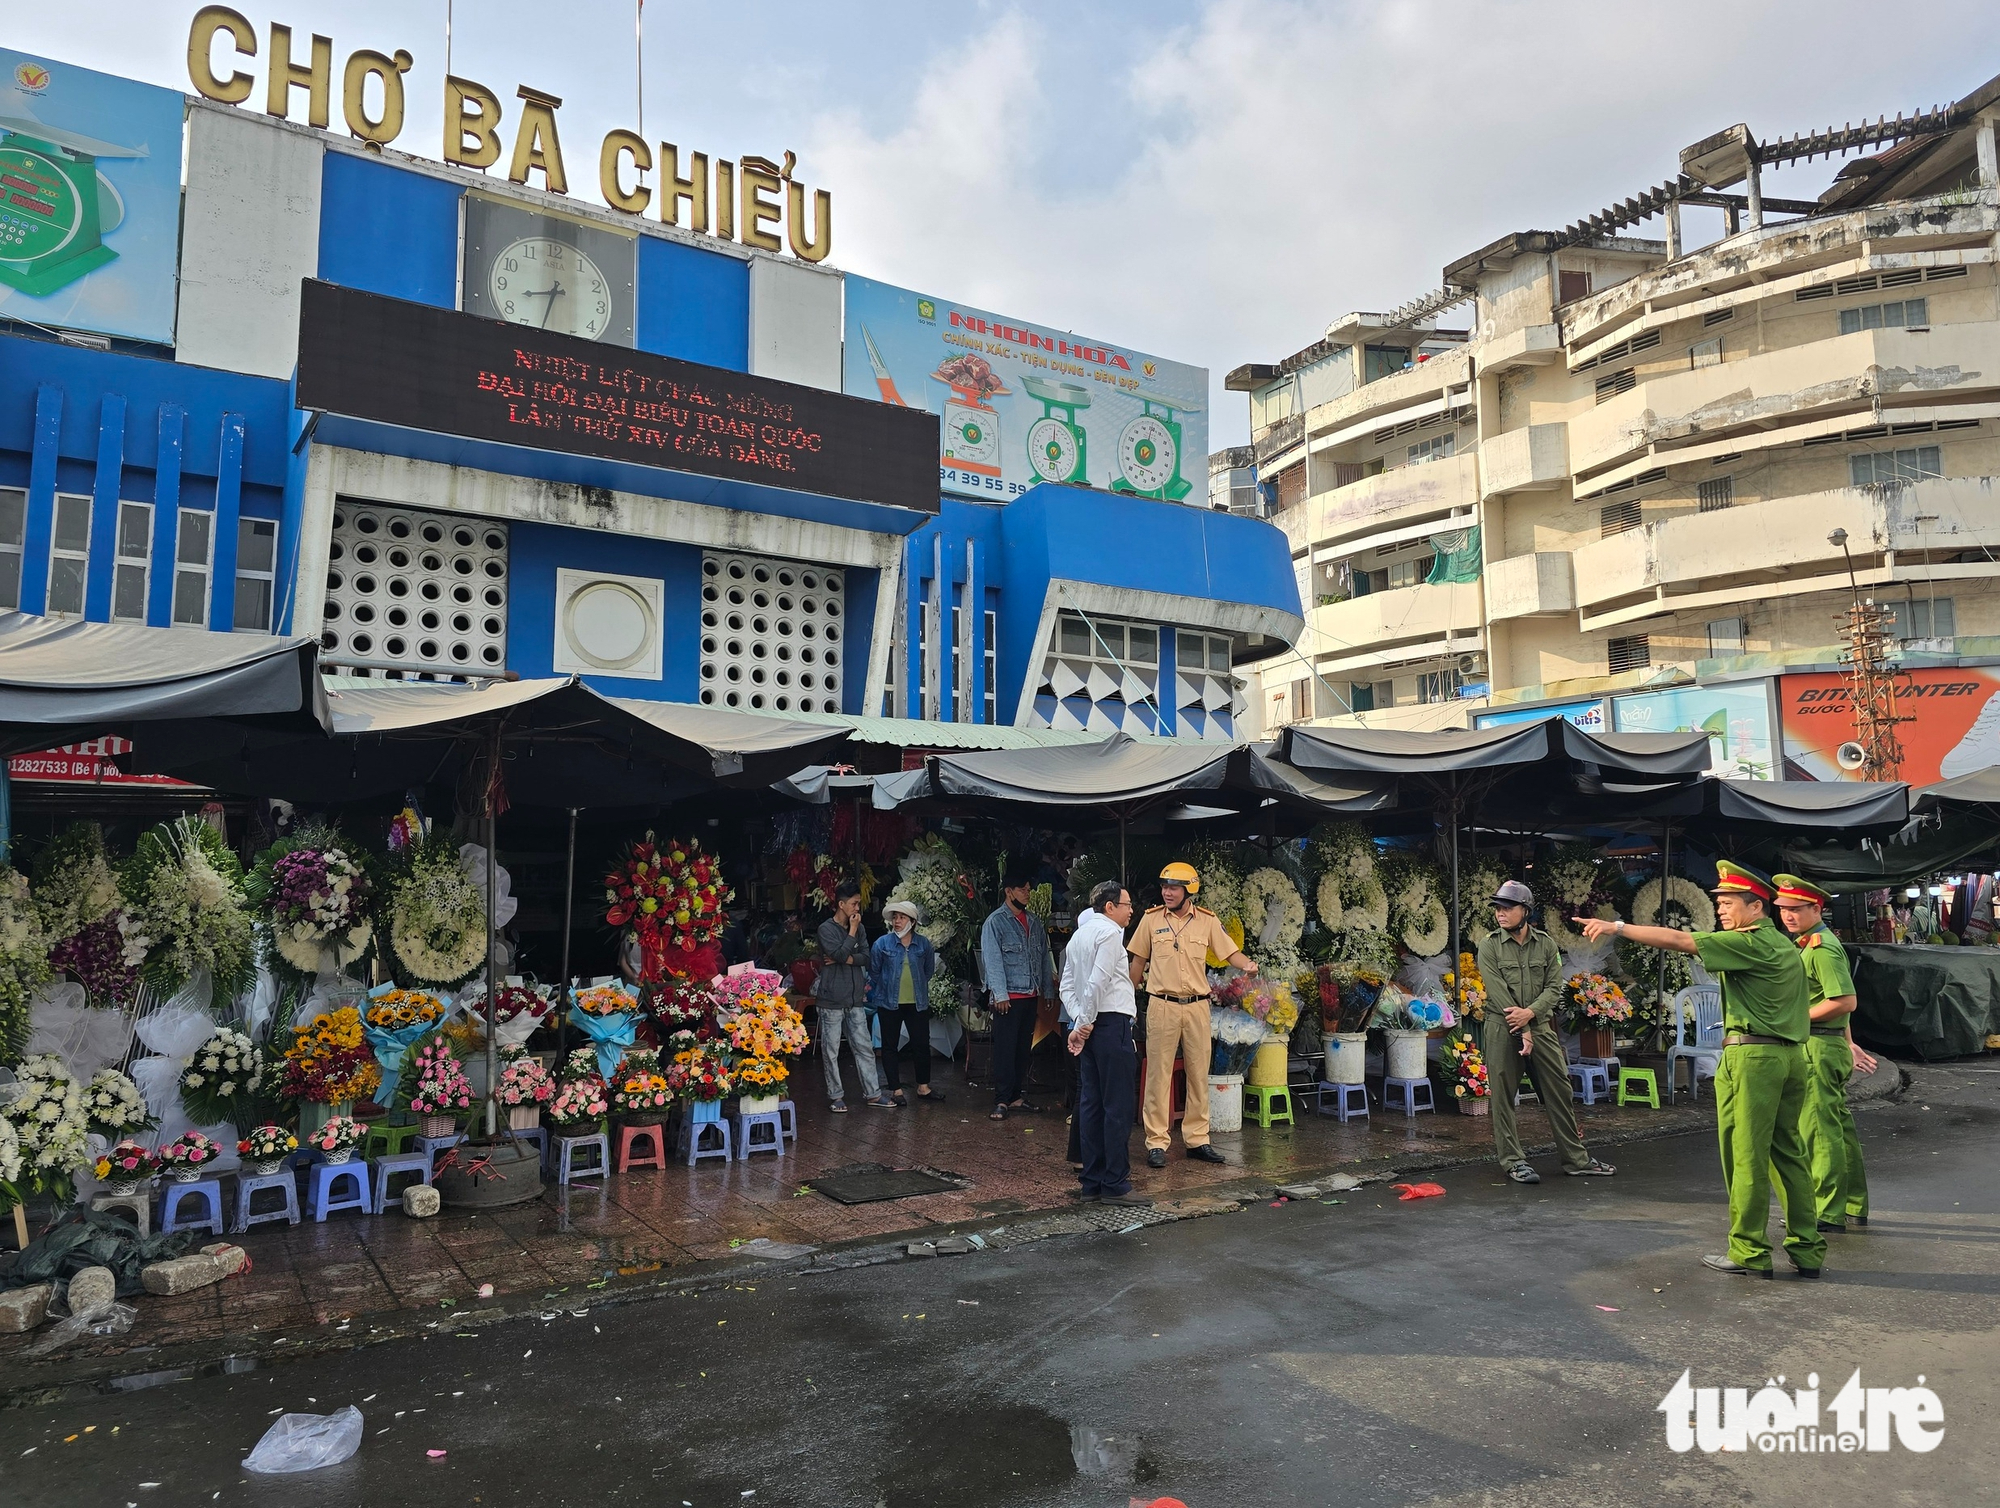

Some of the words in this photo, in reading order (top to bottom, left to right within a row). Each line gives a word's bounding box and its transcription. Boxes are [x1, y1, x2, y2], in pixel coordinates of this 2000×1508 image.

[187, 4, 414, 155] CHỢ
[599, 128, 832, 264] CHIỂU
[522, 244, 538, 261] 11
[546, 243, 564, 260] 12
[502, 256, 519, 273] 10
[543, 260, 566, 272] ASIA
[497, 276, 508, 291] 9
[591, 279, 602, 294] 2
[504, 299, 515, 315] 8
[595, 300, 607, 315] 3
[585, 319, 597, 334] 4
[941, 331, 984, 352] CHÍNH
[985, 342, 1011, 360] XÁC
[1020, 351, 1048, 369] TIỆN
[1050, 360, 1085, 377] DỤNG
[1119, 377, 1140, 392] ĐẸP
[626, 423, 669, 449] XIV
[961, 472, 980, 487] 39
[985, 477, 1003, 491] 55
[8, 759, 68, 774] 12827533
